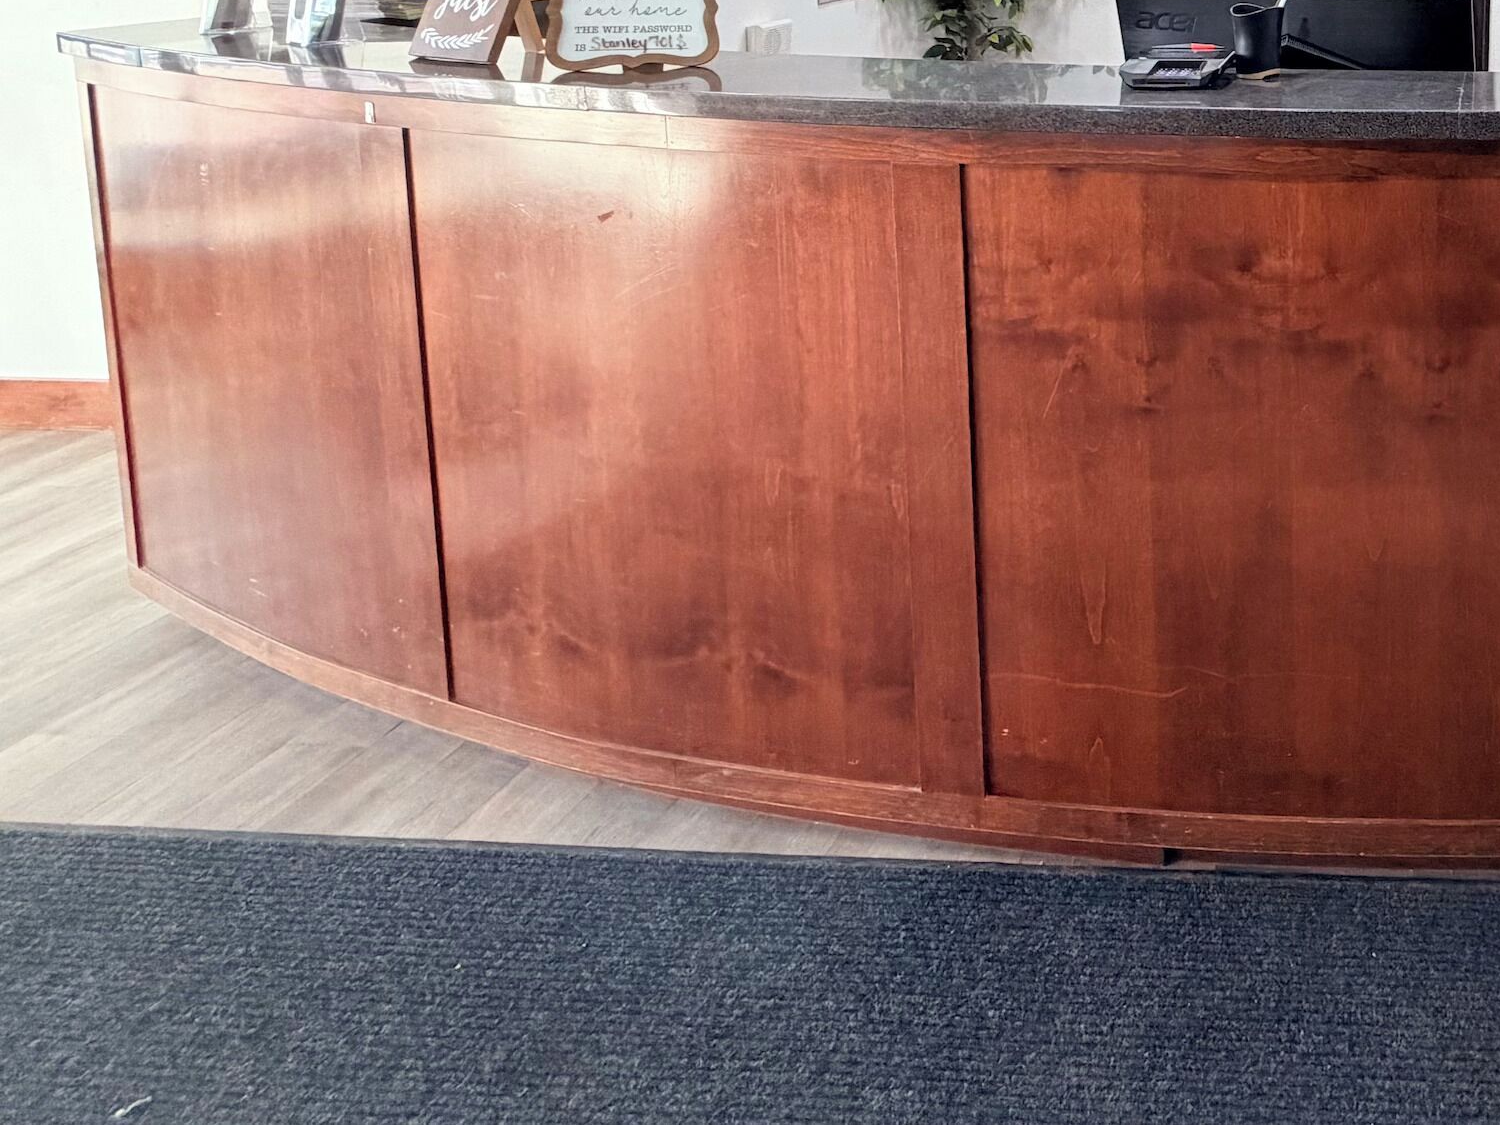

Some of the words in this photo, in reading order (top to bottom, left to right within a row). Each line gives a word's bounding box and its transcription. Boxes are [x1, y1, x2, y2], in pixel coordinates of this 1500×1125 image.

[583, 4, 623, 17] our
[574, 26, 599, 34] THE
[602, 25, 630, 34] WIFI
[632, 24, 693, 34] PASSWORD
[574, 43, 586, 52] IS
